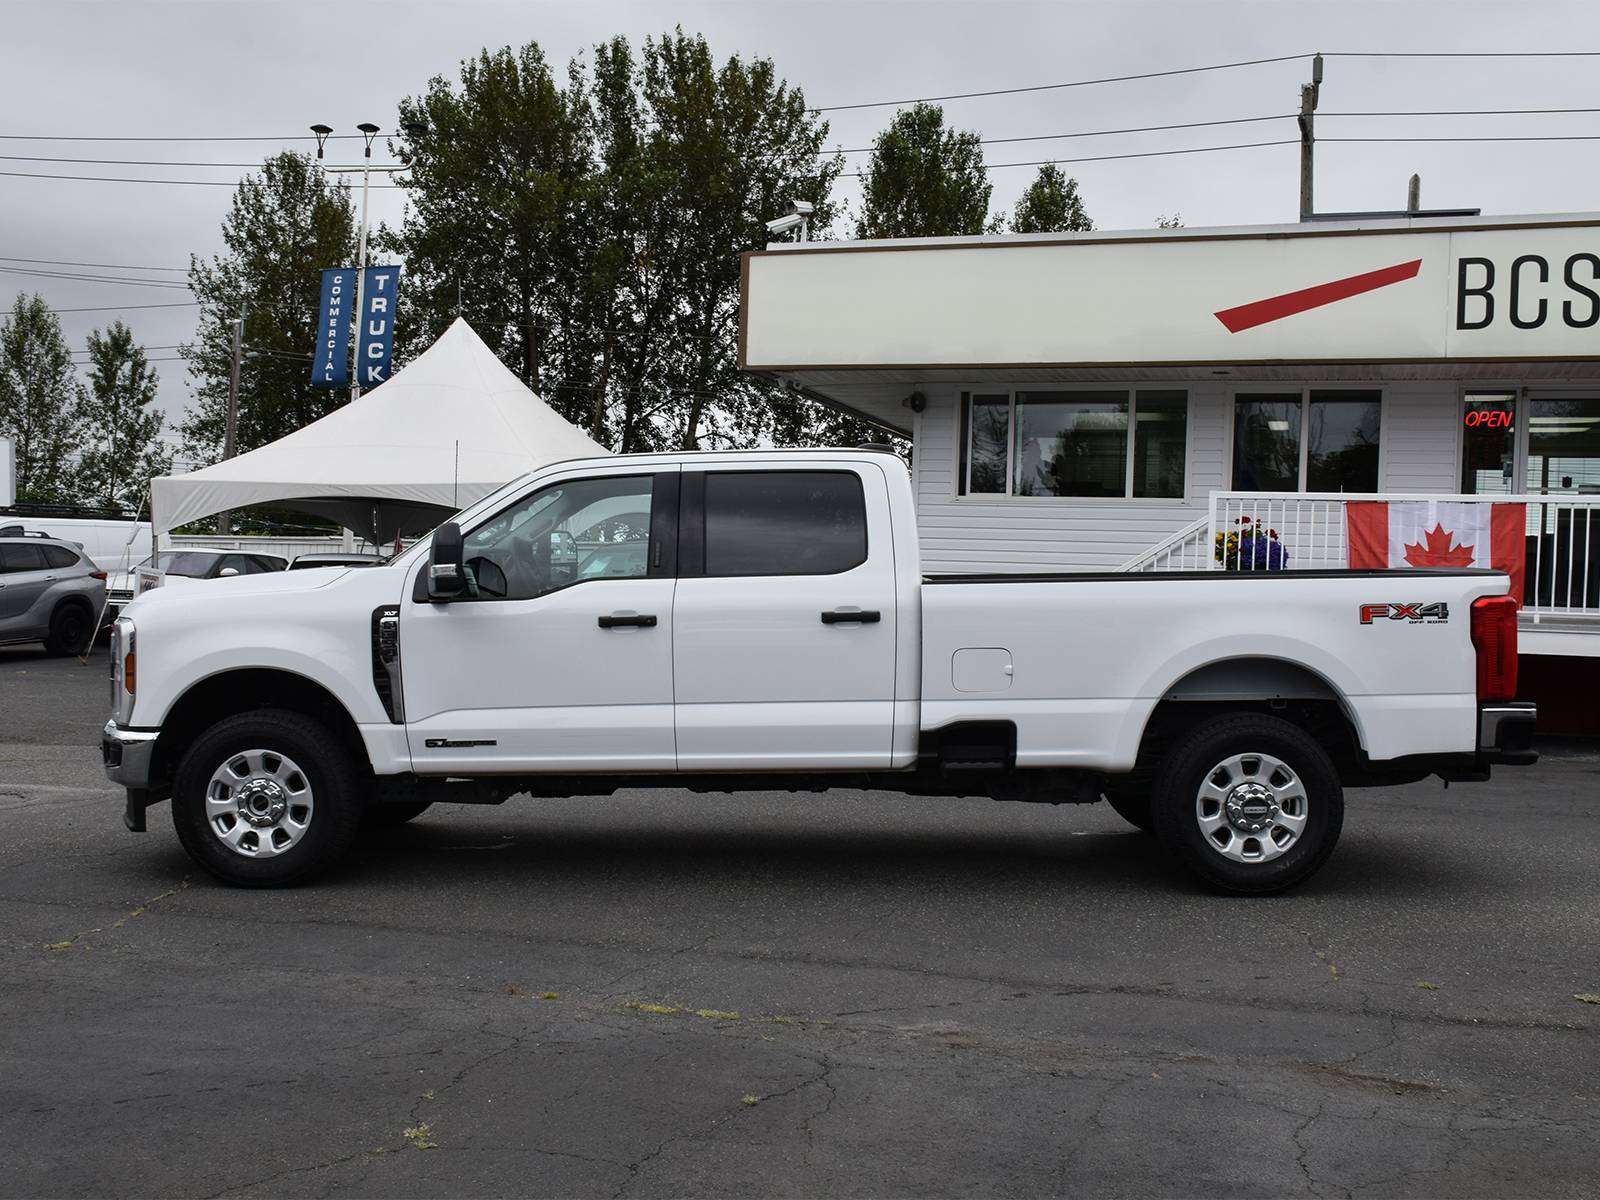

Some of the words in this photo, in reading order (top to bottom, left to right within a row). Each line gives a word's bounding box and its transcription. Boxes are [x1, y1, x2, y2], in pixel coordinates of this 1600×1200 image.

[325, 276, 343, 381] COMMERCIAL
[368, 275, 389, 382] TRUCK
[1456, 252, 1600, 330] BCS
[1465, 411, 1513, 427] OPEN
[1359, 602, 1449, 625] FX4
